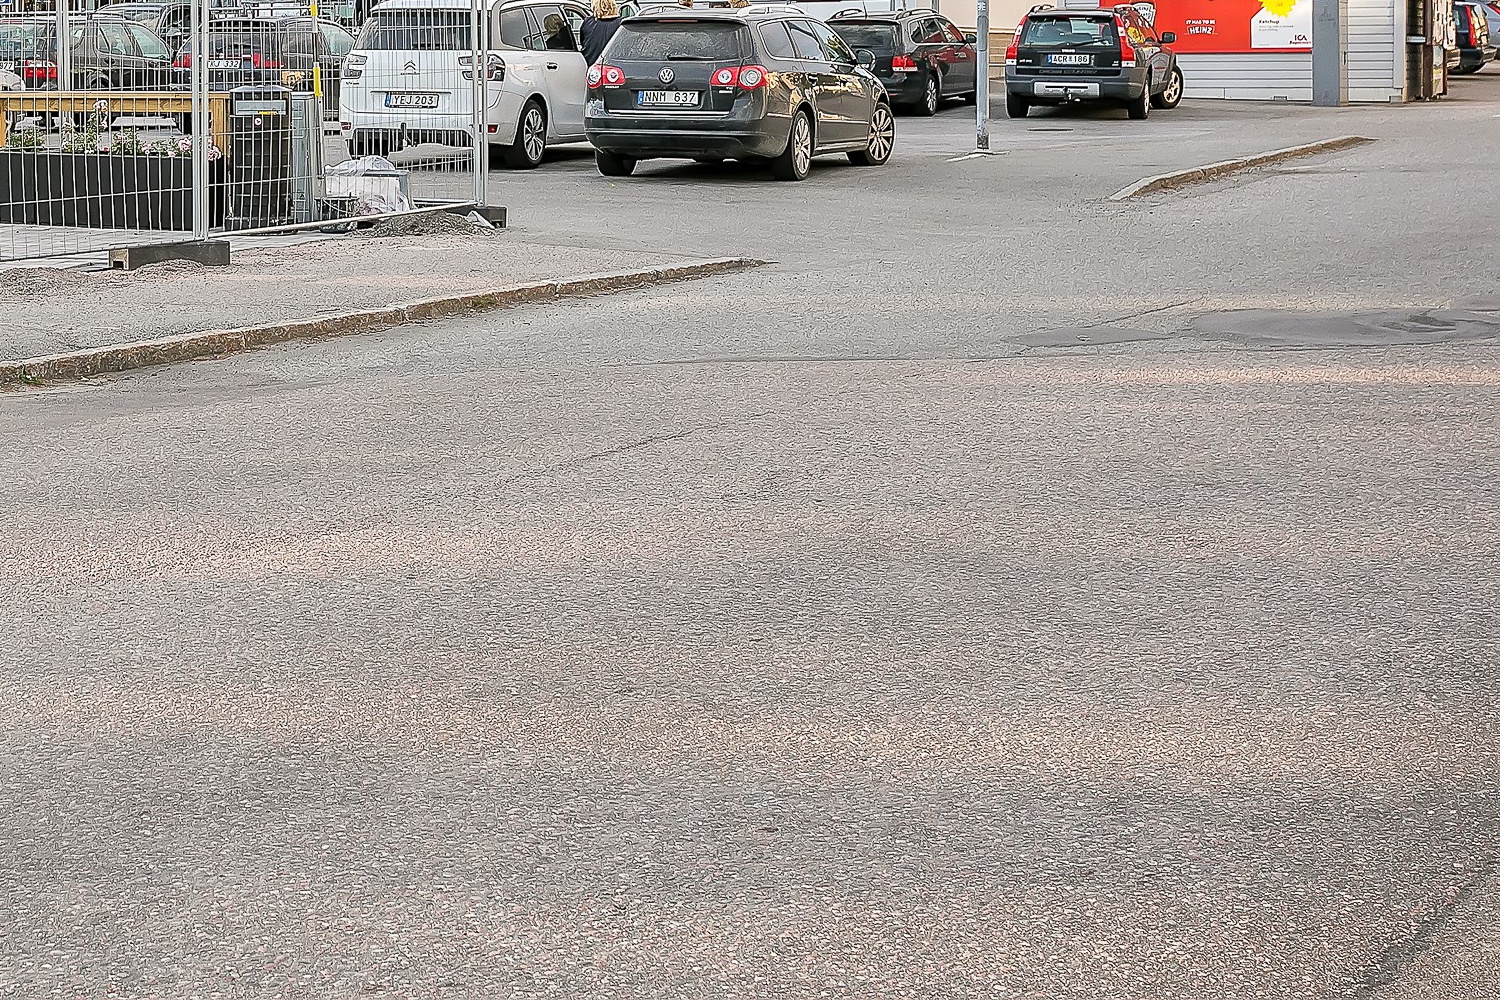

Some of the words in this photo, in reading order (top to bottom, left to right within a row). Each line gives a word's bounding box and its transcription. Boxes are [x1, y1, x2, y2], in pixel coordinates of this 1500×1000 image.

[1189, 26, 1214, 35] HEINZ
[1053, 55, 1068, 63] ACR
[1074, 55, 1088, 63] 186
[394, 95, 412, 105] YEJ
[414, 95, 434, 105] 203
[644, 91, 666, 102] NNM
[673, 91, 696, 103] 637
